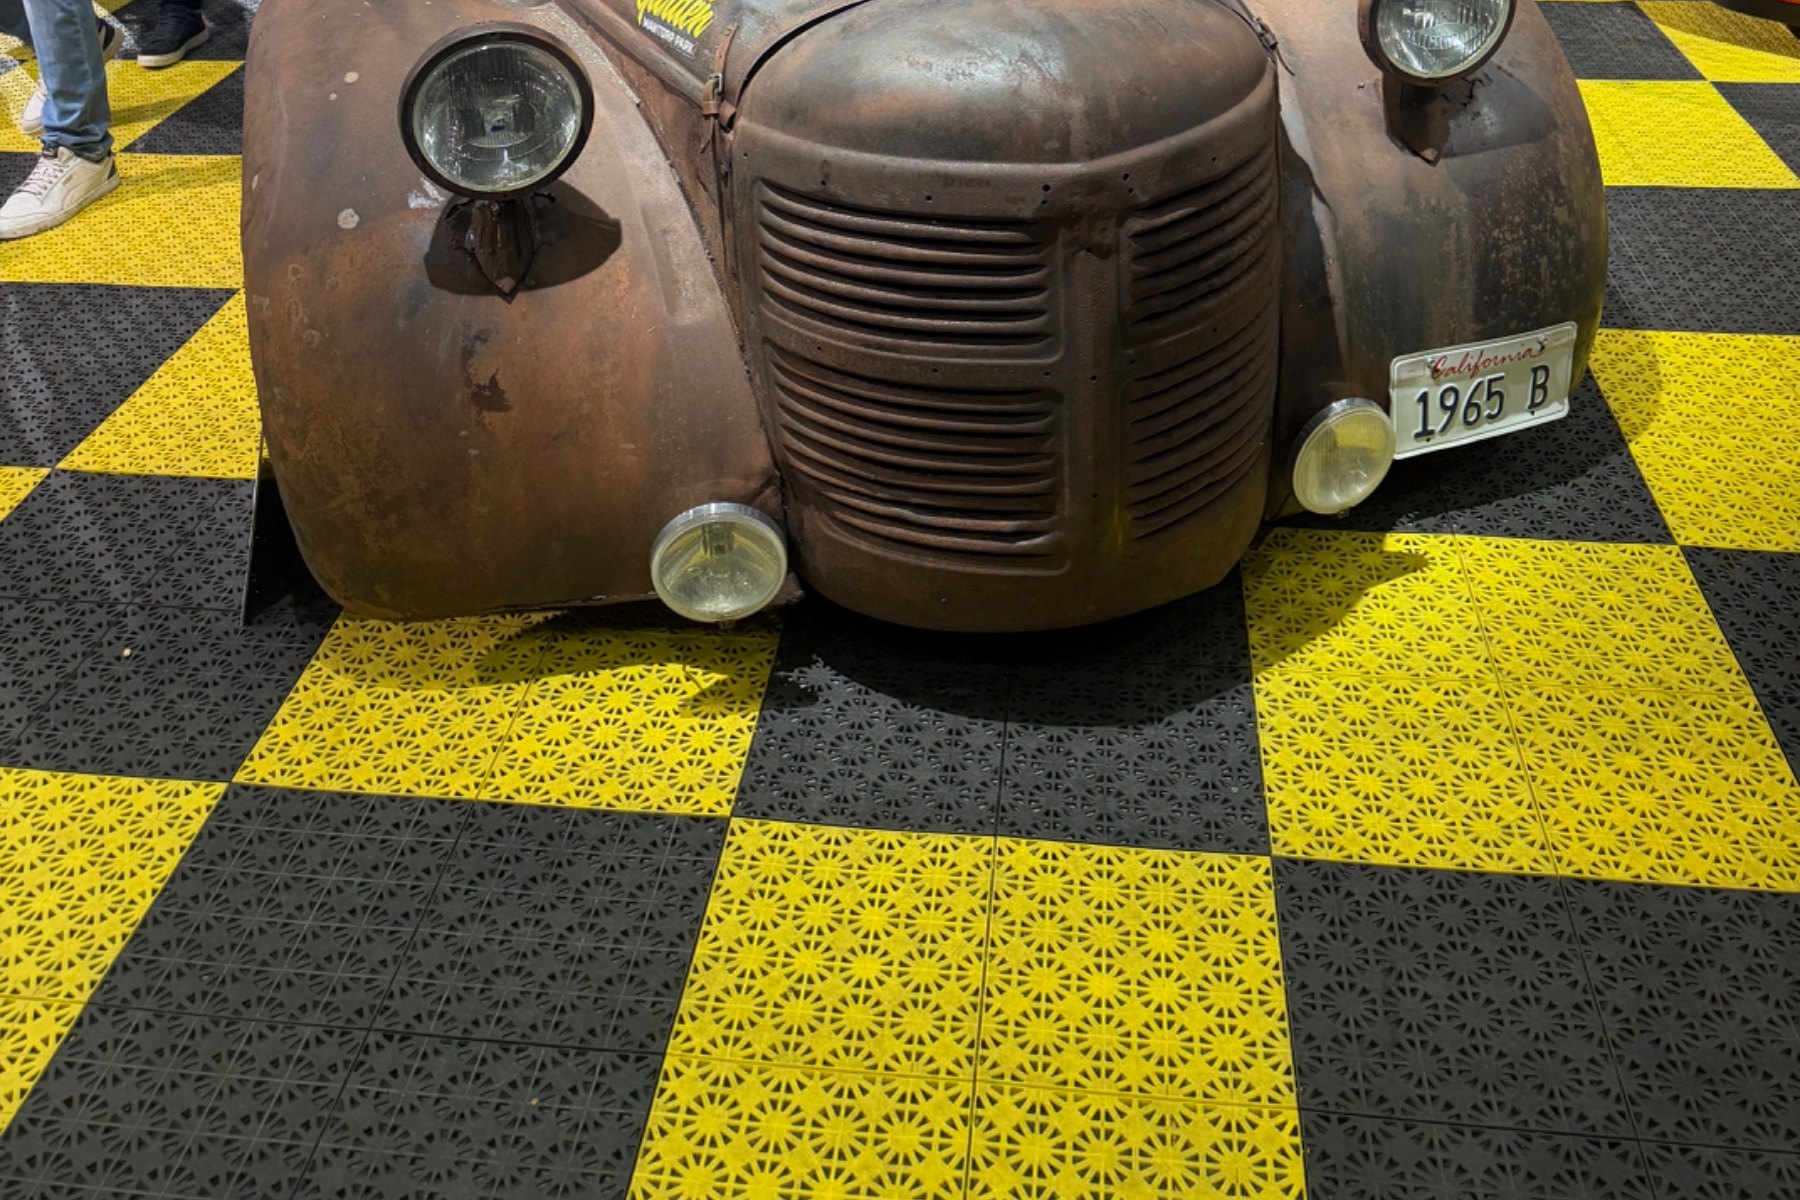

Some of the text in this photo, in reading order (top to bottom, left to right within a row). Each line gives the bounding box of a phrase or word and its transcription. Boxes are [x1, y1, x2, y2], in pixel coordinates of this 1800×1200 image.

[1431, 346, 1541, 380] California
[1414, 364, 1551, 439] 1965 B
